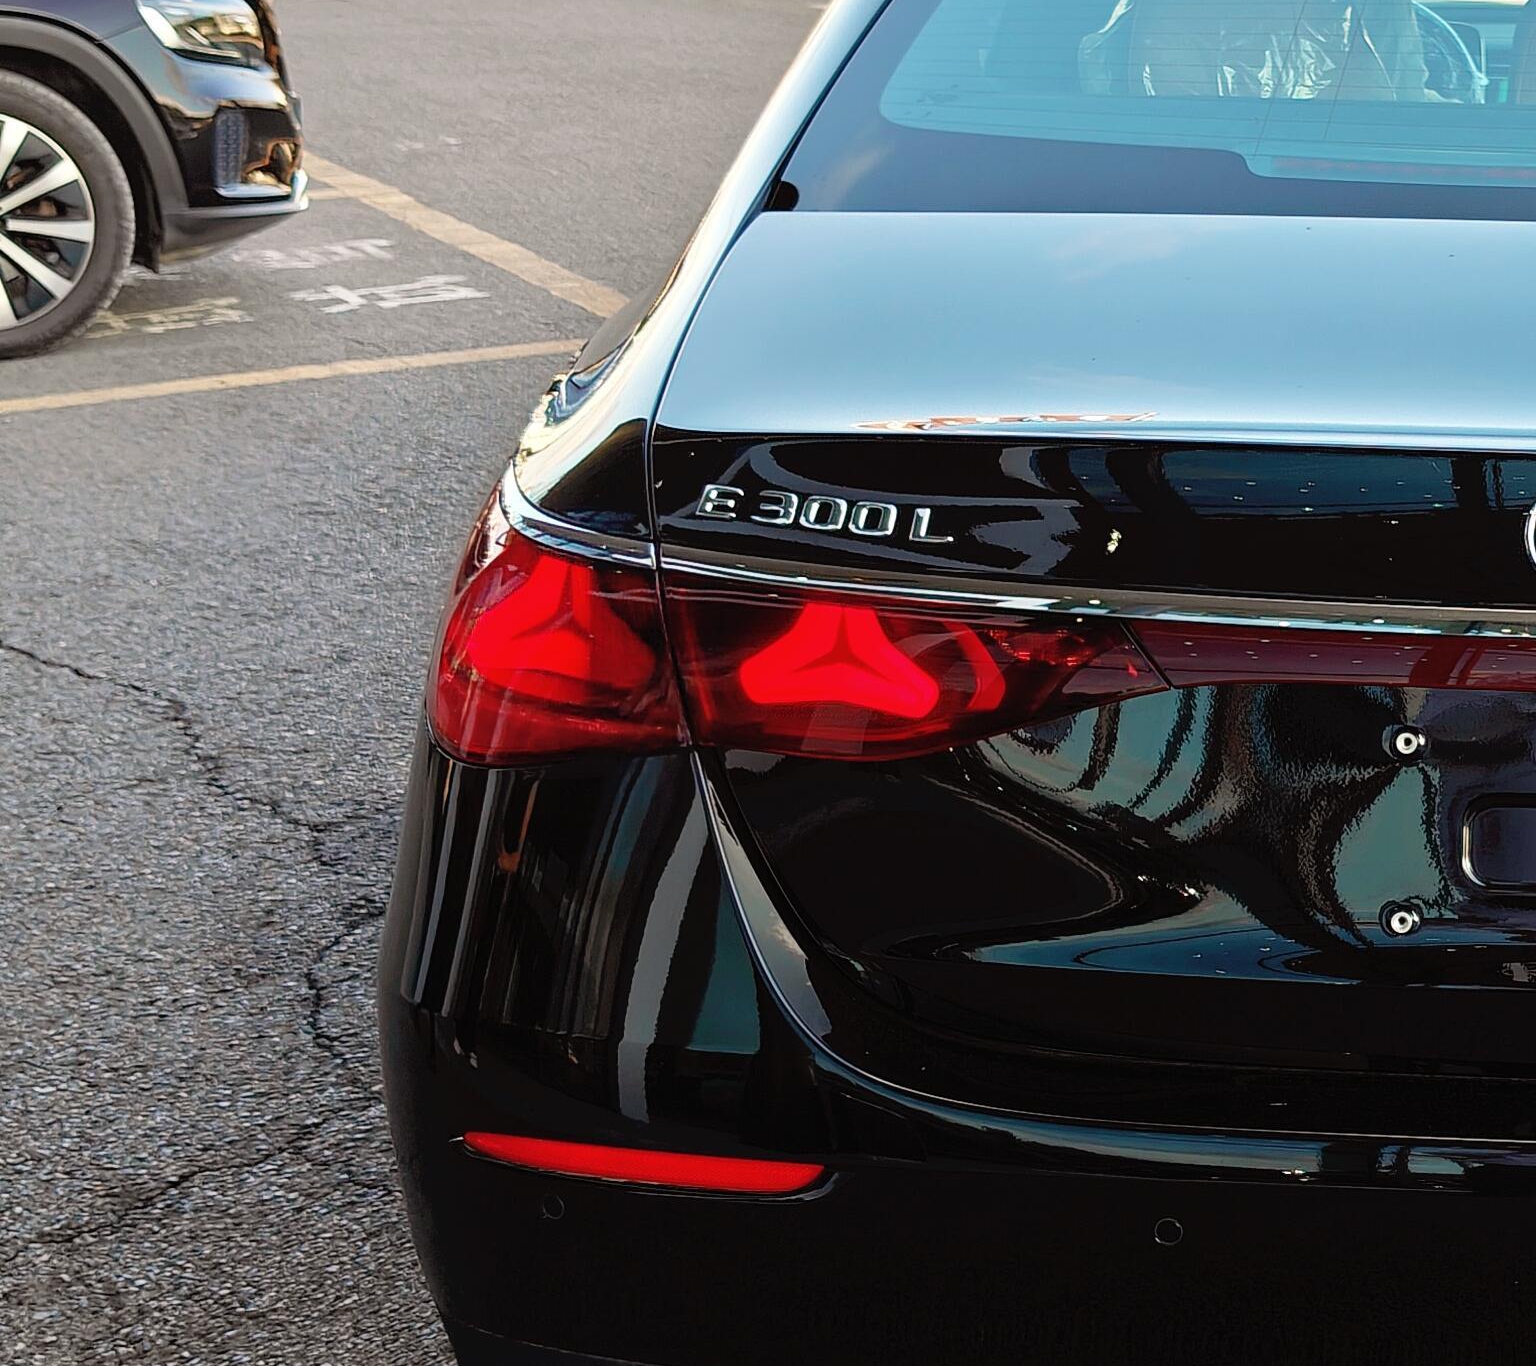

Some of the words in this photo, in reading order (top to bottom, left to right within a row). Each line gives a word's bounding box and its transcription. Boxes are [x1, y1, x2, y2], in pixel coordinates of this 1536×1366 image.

[694, 482, 745, 520] E
[750, 488, 899, 538] 300
[908, 506, 955, 544] L
